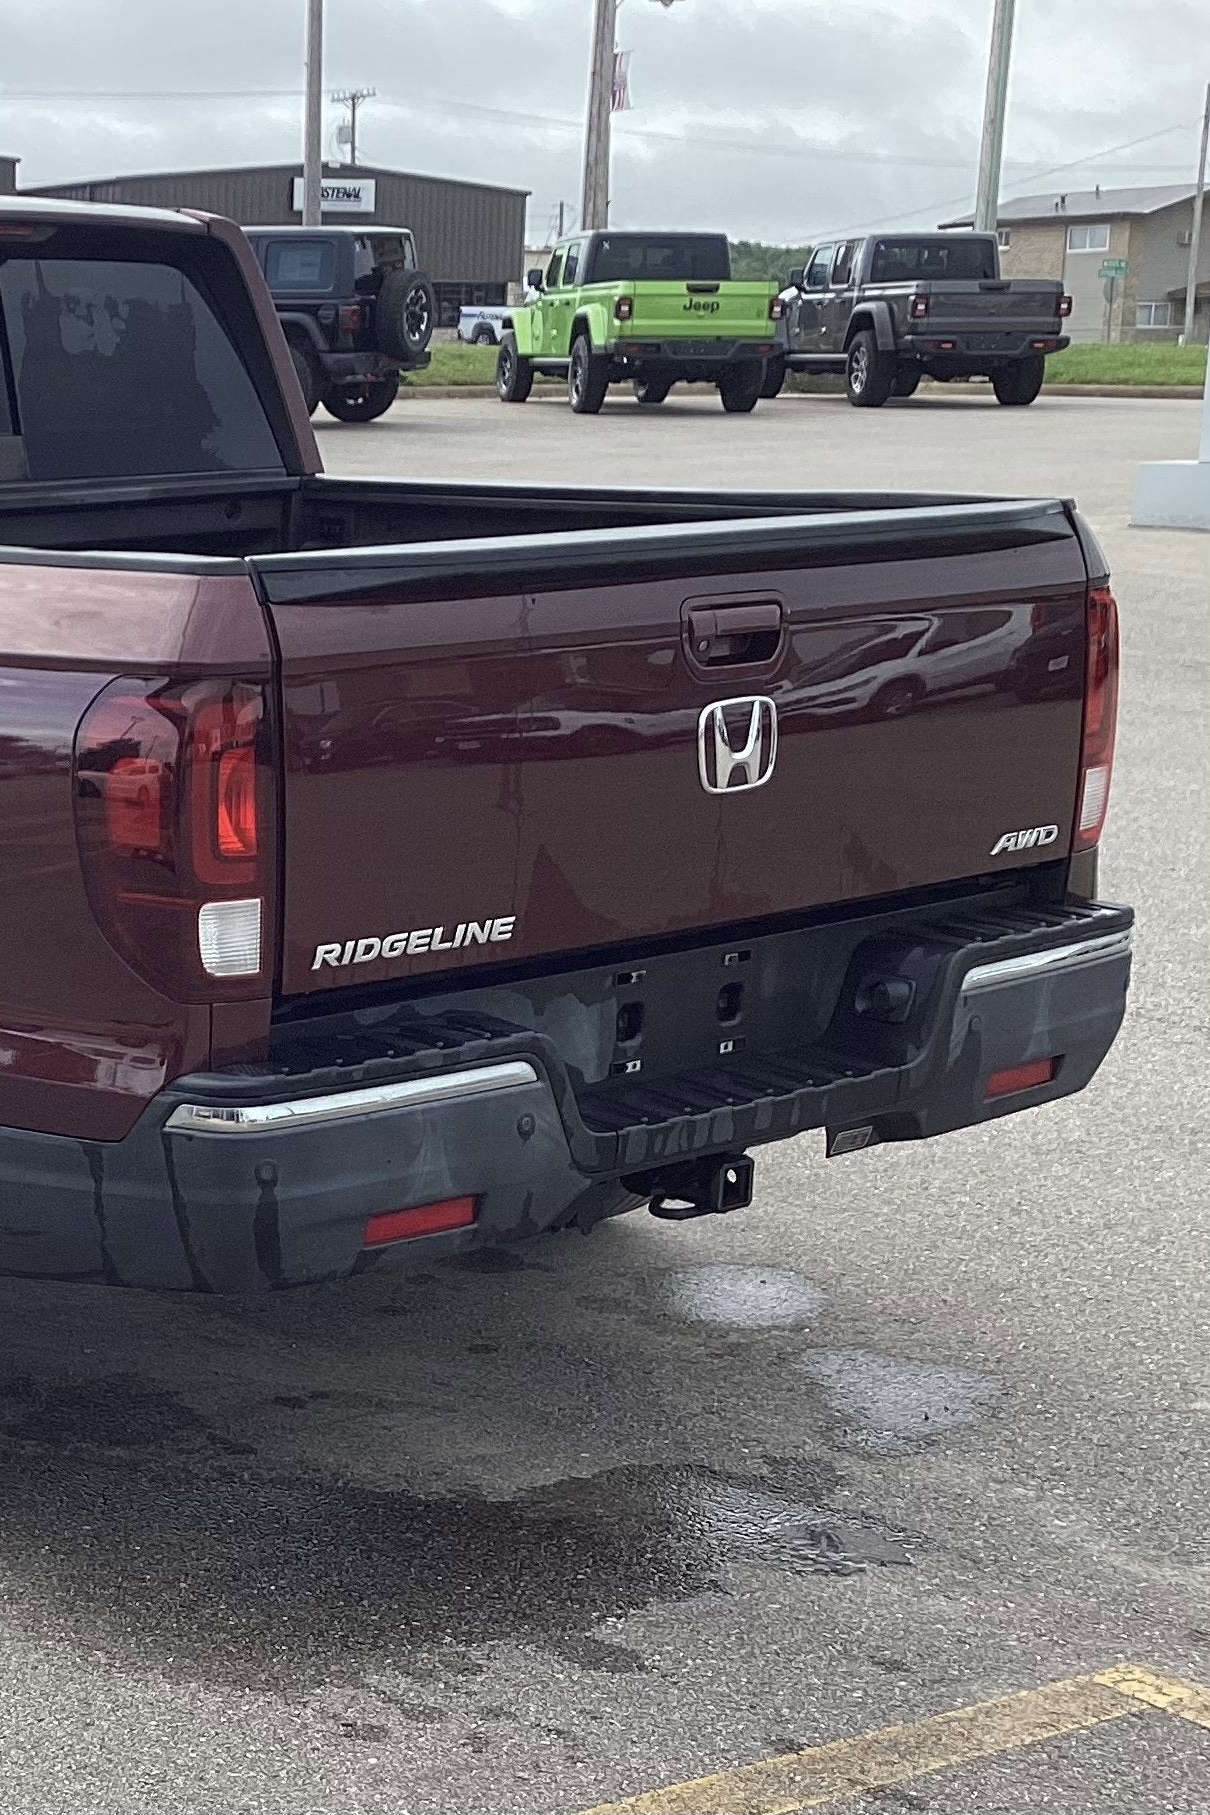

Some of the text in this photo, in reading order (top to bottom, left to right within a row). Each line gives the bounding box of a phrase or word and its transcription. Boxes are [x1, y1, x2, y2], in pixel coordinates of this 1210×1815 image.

[683, 298, 720, 314] Jeep
[990, 825, 1059, 856] AWD
[311, 915, 517, 970] RIDGELINE
